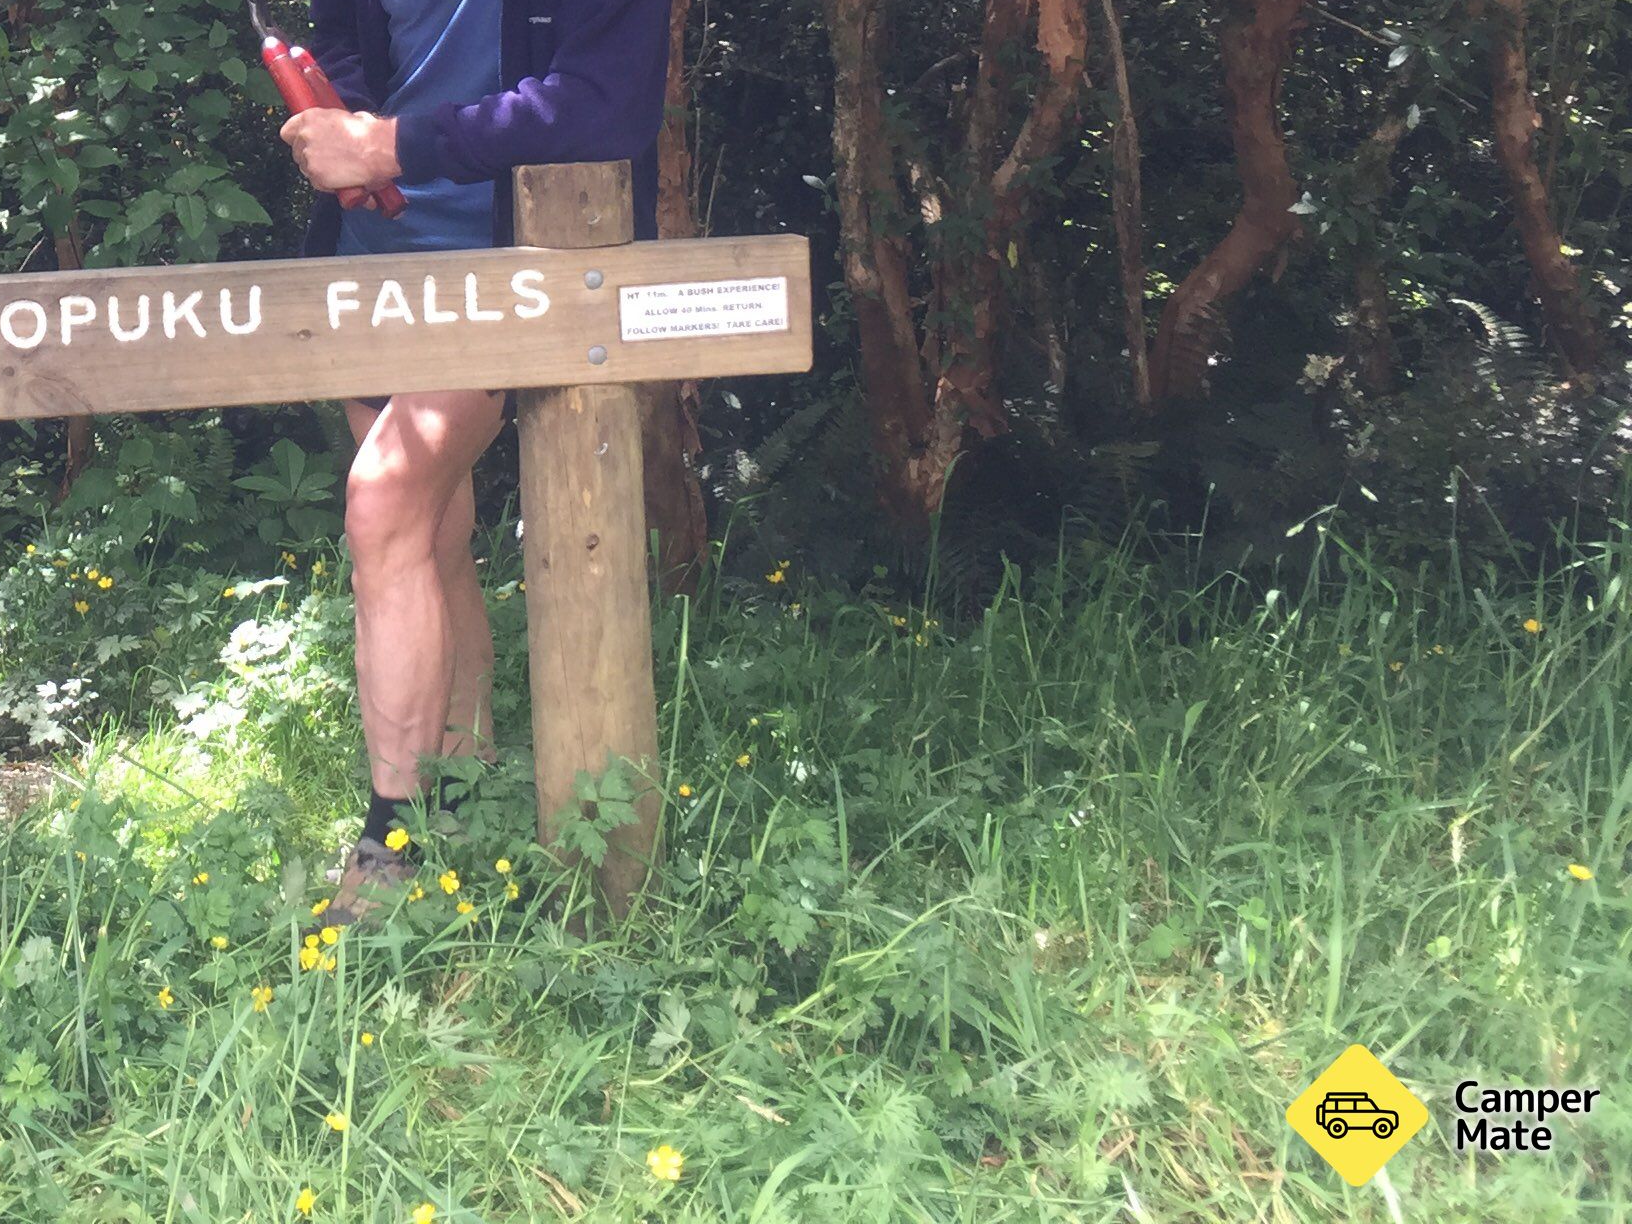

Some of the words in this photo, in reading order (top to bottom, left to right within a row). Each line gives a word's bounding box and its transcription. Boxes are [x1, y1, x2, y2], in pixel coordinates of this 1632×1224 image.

[687, 287, 714, 296] BUSH
[717, 283, 780, 294] EXPERIENCE!
[326, 269, 551, 329] FALLS
[645, 307, 678, 316] ALLOW
[723, 302, 762, 311] RETURN
[627, 326, 667, 335] FOLLOW
[670, 322, 719, 332] MARKERS!
[727, 320, 752, 329] TAKE
[755, 318, 783, 327] CARE!
